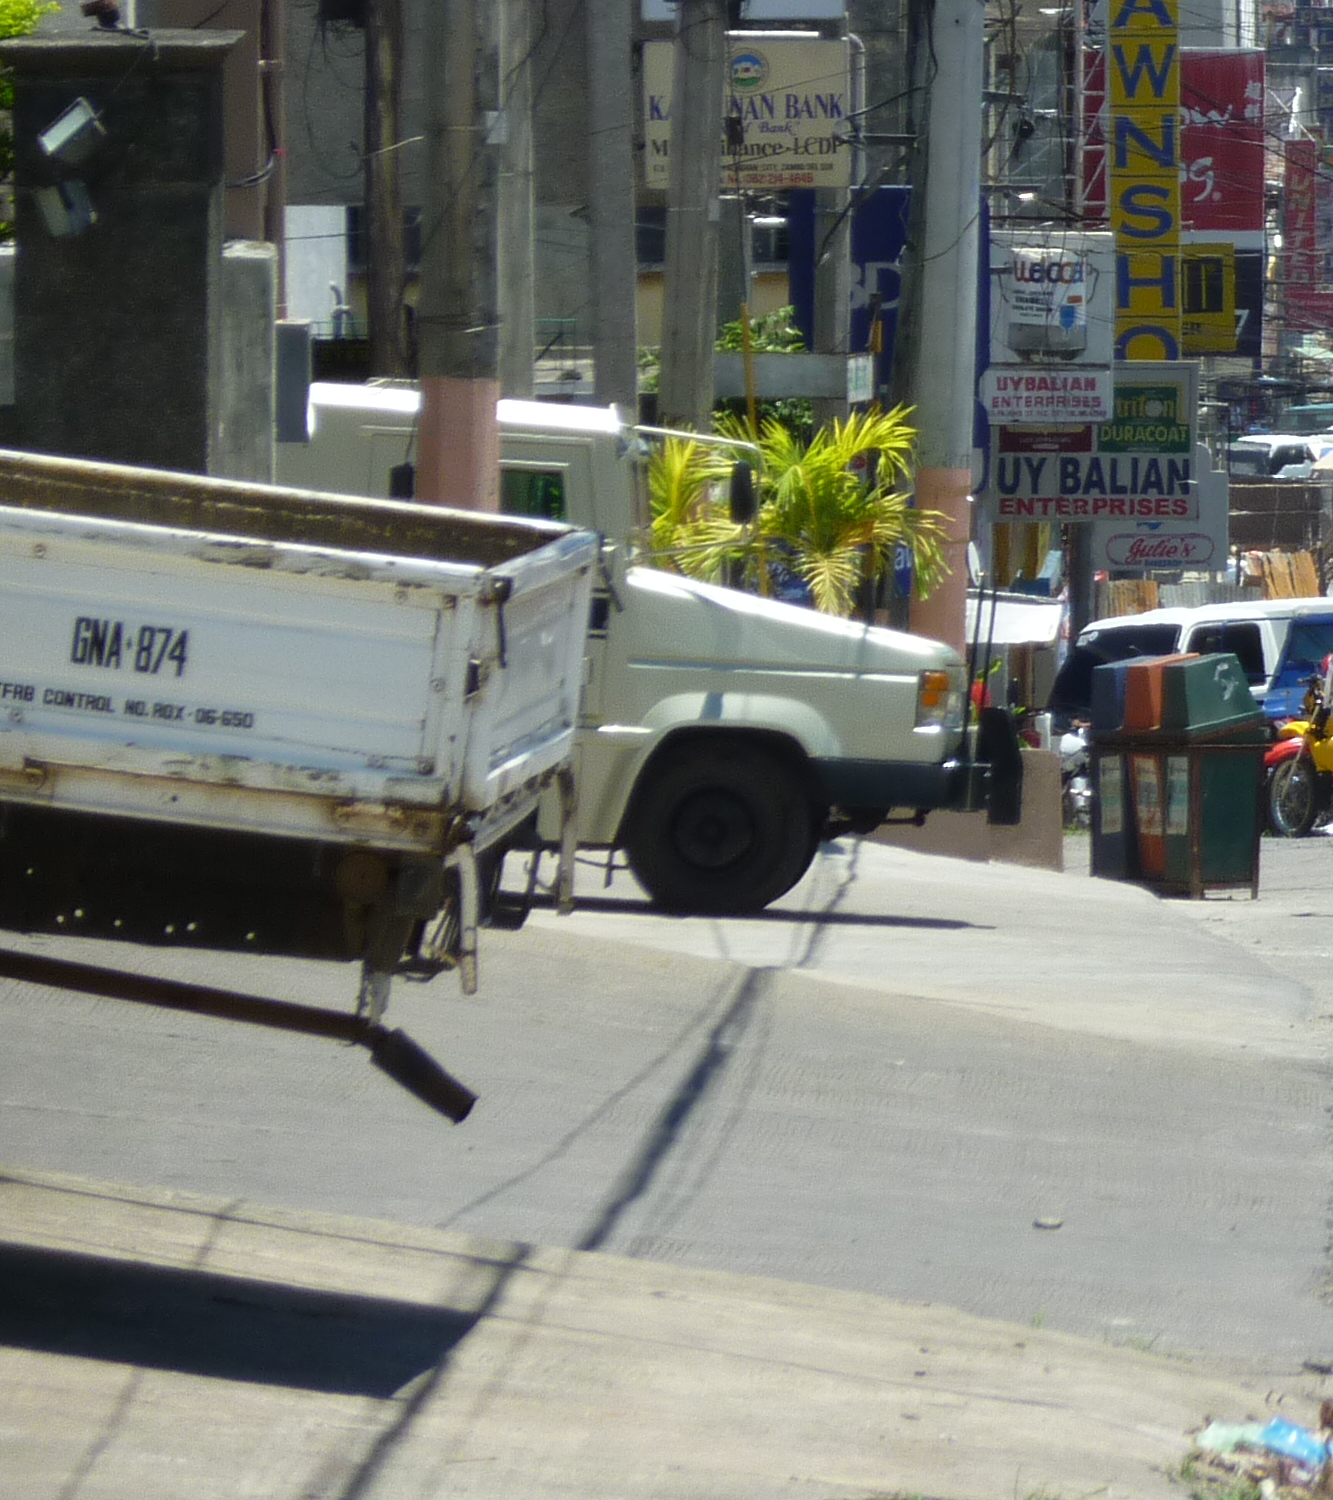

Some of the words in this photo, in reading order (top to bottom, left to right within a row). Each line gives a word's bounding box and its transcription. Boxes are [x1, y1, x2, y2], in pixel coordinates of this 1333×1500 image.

[1102, 425, 1188, 443] DURACOAT
[997, 456, 1048, 495] UY
[1059, 456, 1191, 495] BALIAN
[999, 497, 1189, 516] ENTERPRISES
[43, 688, 116, 714] CONTROL
